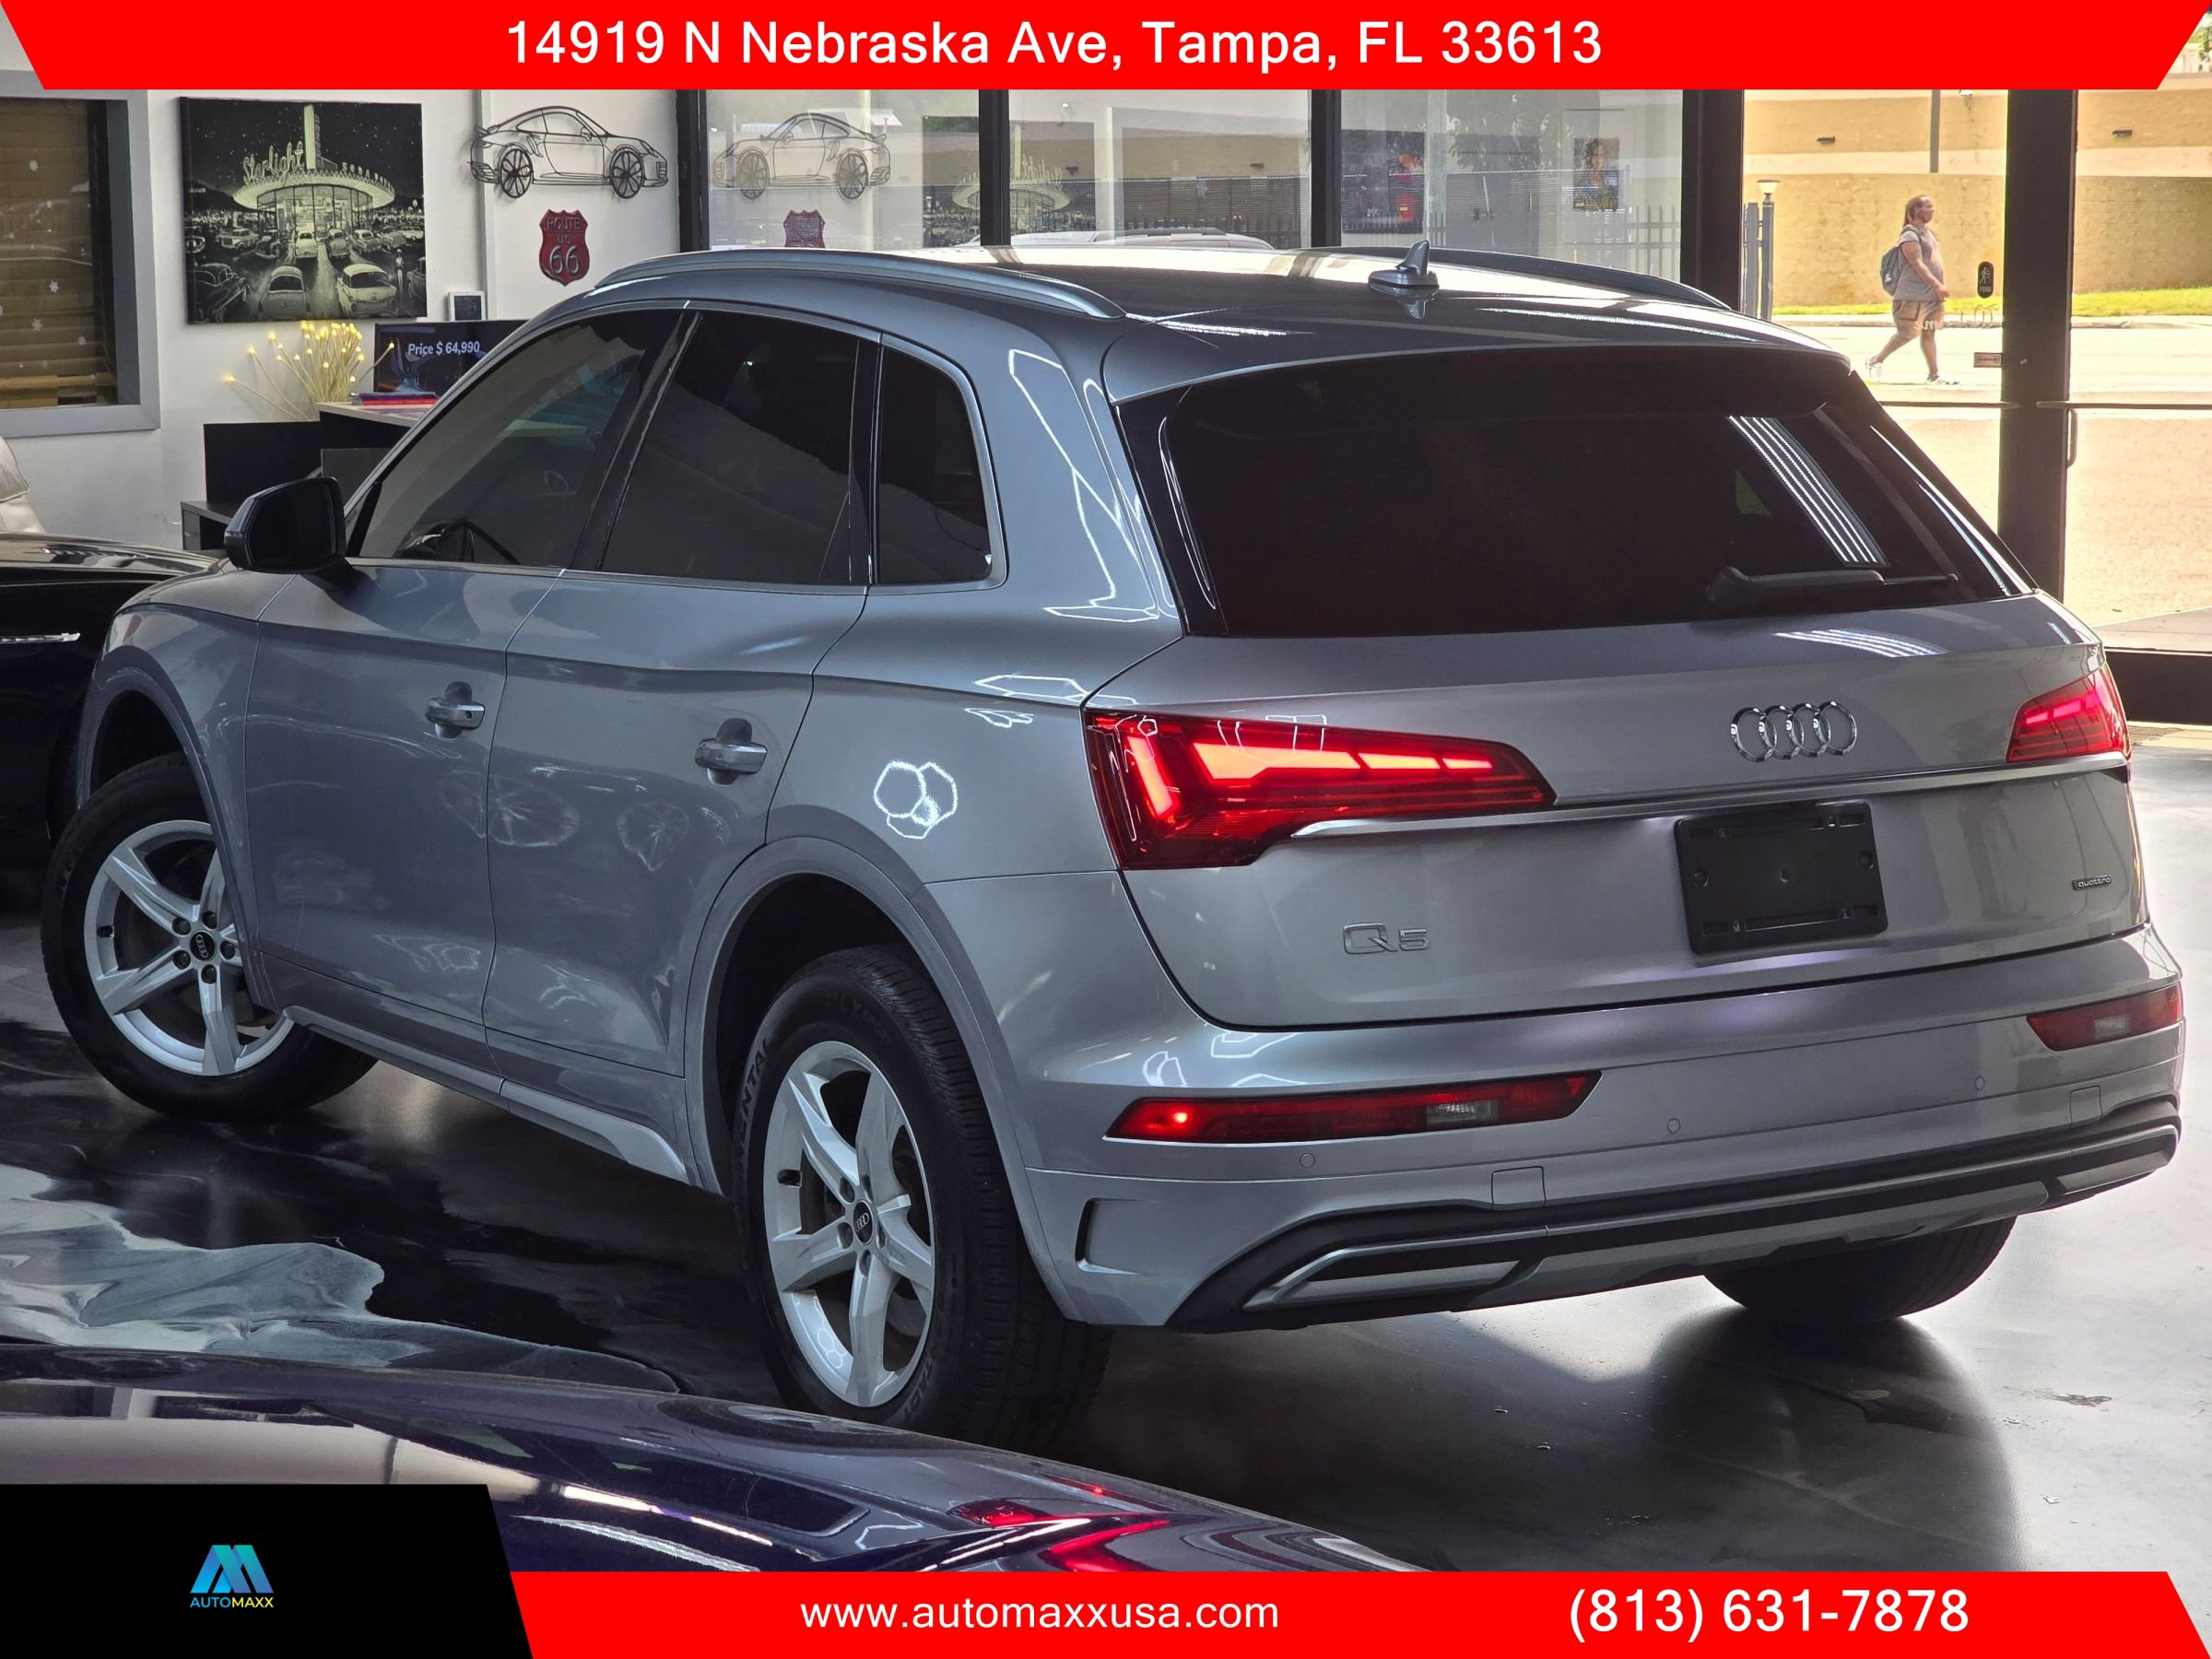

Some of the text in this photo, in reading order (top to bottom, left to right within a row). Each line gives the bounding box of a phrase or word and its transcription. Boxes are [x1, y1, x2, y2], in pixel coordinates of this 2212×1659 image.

[242, 141, 306, 185] Starlight
[547, 217, 582, 229] ROUTE
[549, 245, 579, 274] 66
[407, 341, 480, 357] Price $ 64,990
[2077, 877, 2111, 888] quattro
[1343, 922, 1430, 955] Q5
